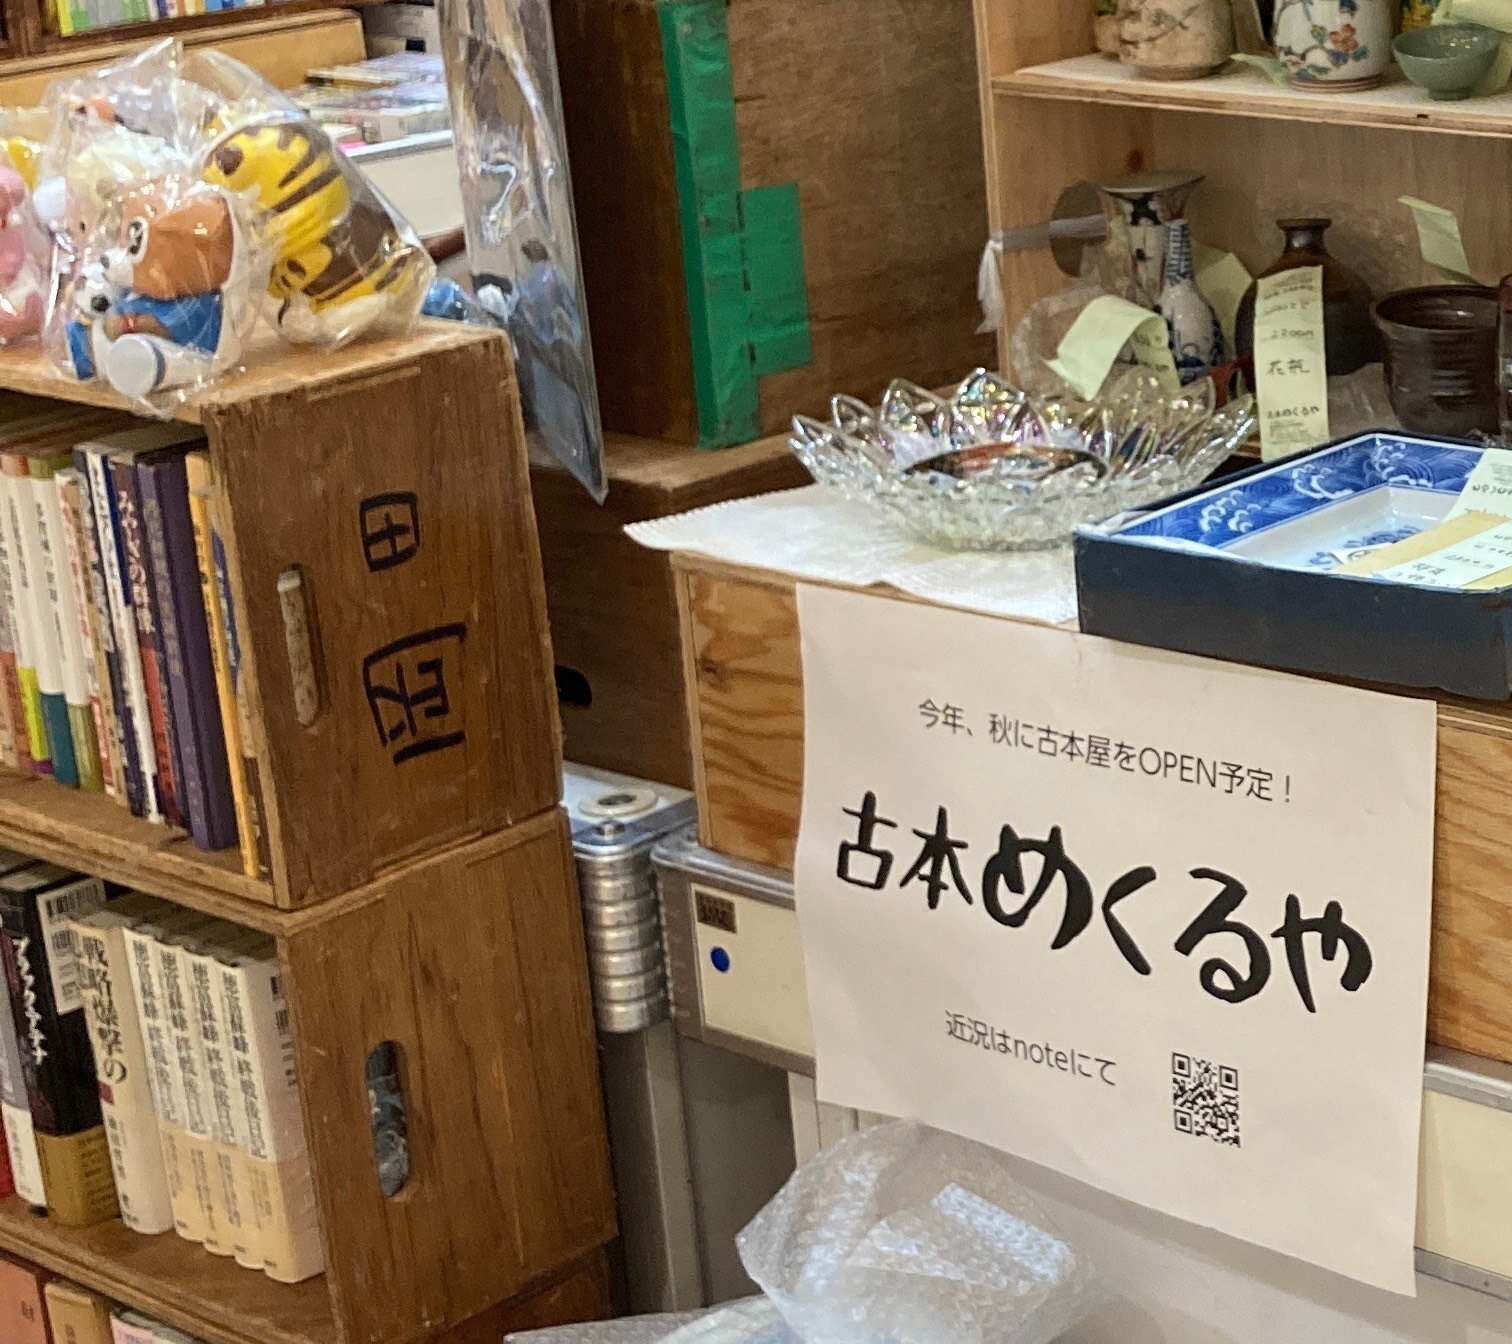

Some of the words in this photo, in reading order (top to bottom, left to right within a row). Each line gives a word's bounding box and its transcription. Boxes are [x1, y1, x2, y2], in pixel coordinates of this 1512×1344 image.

[918, 698, 1296, 803] 今年、秋に古本屋をOPEN予定！
[836, 790, 1373, 1013] 古本めくるや
[944, 1009, 1118, 1087] 近況はnoteにて
